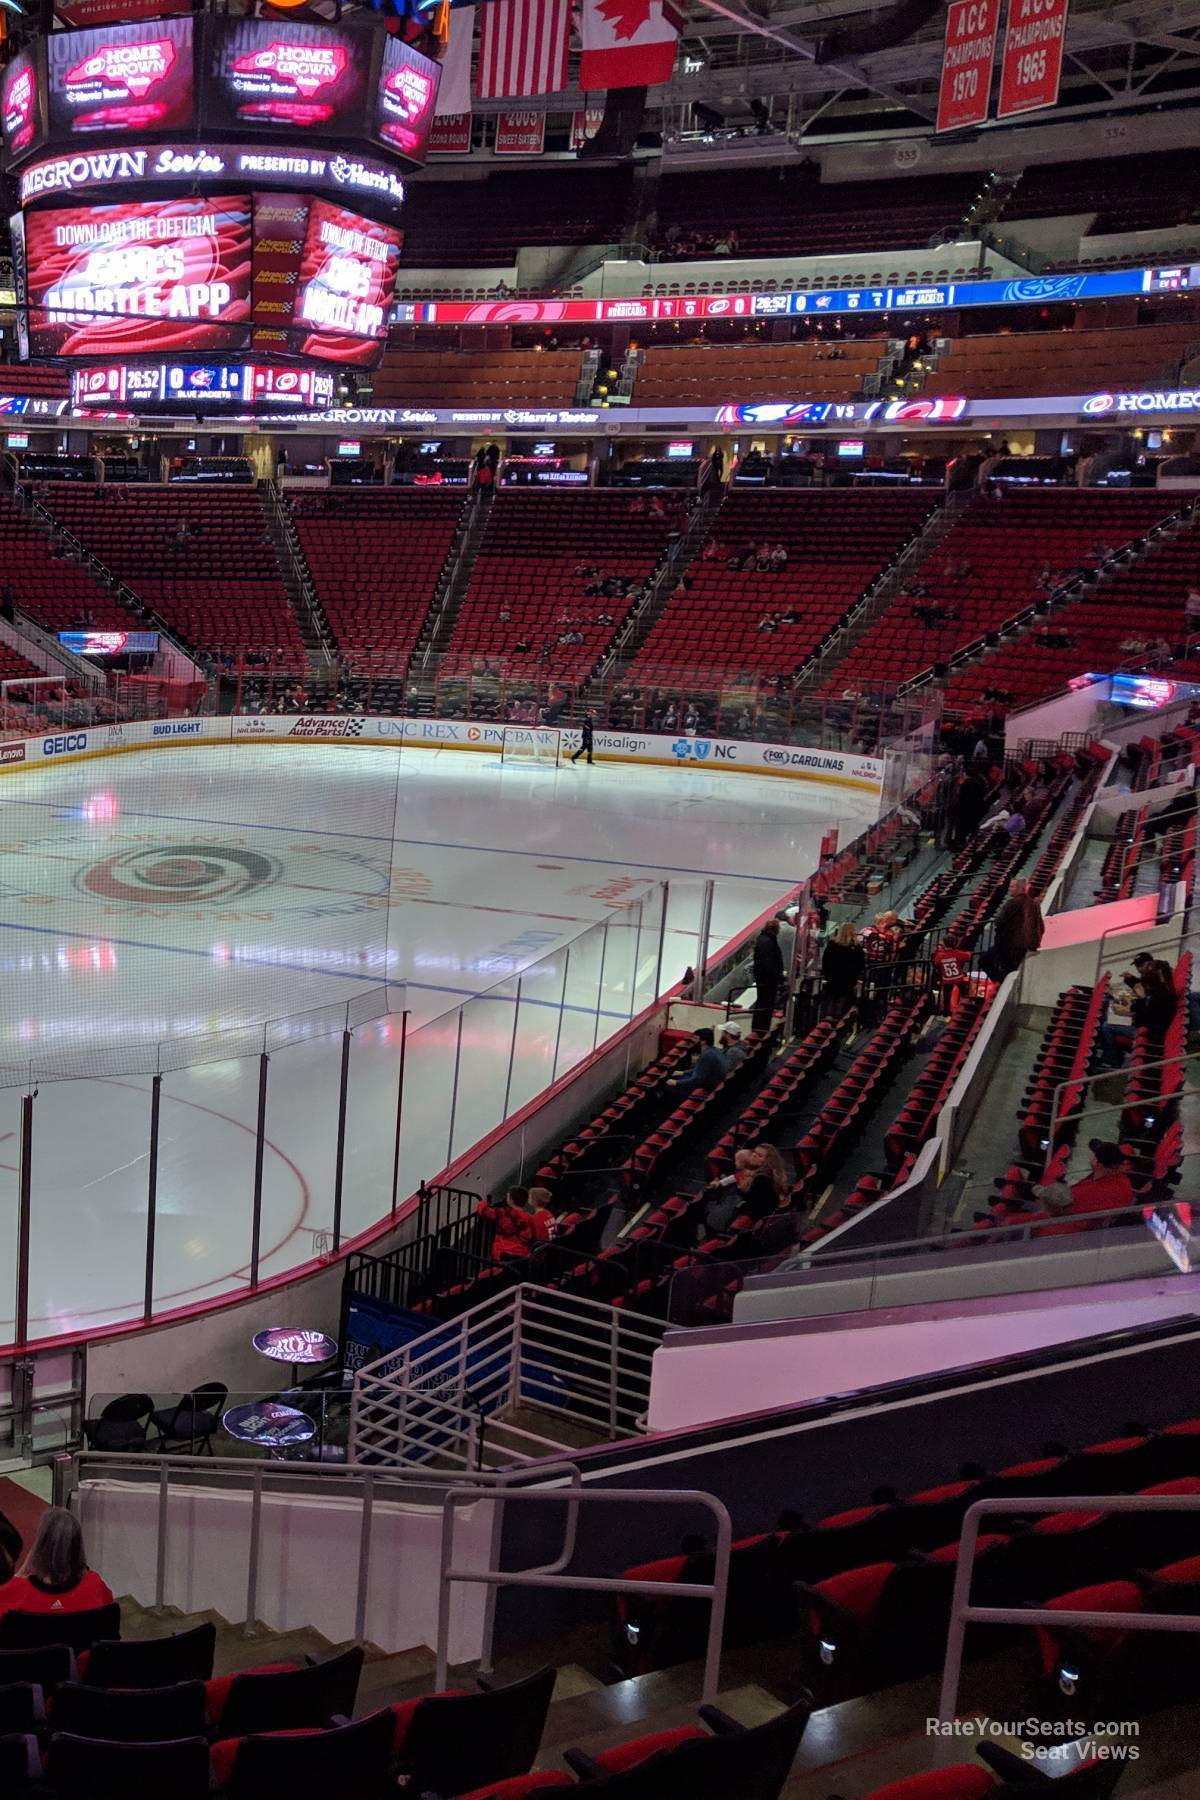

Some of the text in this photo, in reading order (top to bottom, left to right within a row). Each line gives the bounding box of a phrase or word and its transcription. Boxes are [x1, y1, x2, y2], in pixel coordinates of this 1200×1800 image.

[957, 2, 987, 37] ACC
[1008, 14, 1063, 51] CHAMPIONS
[106, 45, 162, 64] HOME
[278, 46, 334, 63] HOME
[944, 35, 992, 69] CHAMPIONS
[106, 59, 166, 78] GROWN
[276, 60, 337, 77] GROWN
[1016, 49, 1047, 86] 1965
[952, 68, 978, 101] 1970
[498, 133, 541, 145] SWEET SIXTEEN
[22, 149, 389, 200] MEGROWN Series PRESENTED BY Harris
[57, 223, 128, 246] DOWNLOAD
[157, 215, 219, 239] OFFICIAL
[169, 282, 231, 318] APP
[734, 298, 745, 314] 0
[756, 297, 787, 310] 26:52
[795, 294, 807, 311] 0
[108, 370, 119, 390] 0
[127, 370, 160, 388] 26:52
[170, 367, 184, 389] 0
[198, 390, 232, 399] JACKETS
[32, 400, 49, 413] VS
[835, 405, 856, 418] VS
[400, 410, 599, 424] Series PRESENTED BY Harris Teeter
[153, 722, 201, 736] BUD LIGHT
[288, 727, 343, 737] Auto Parts
[294, 717, 346, 729] Advance
[377, 721, 460, 740] UNC REX
[43, 734, 87, 755] GEICO
[592, 735, 646, 752] nvisalign
[714, 744, 737, 759] NC
[0, 748, 24, 760] Lenovo
[768, 751, 845, 771] FOX CAROLINAS
[943, 962, 960, 977] 53
